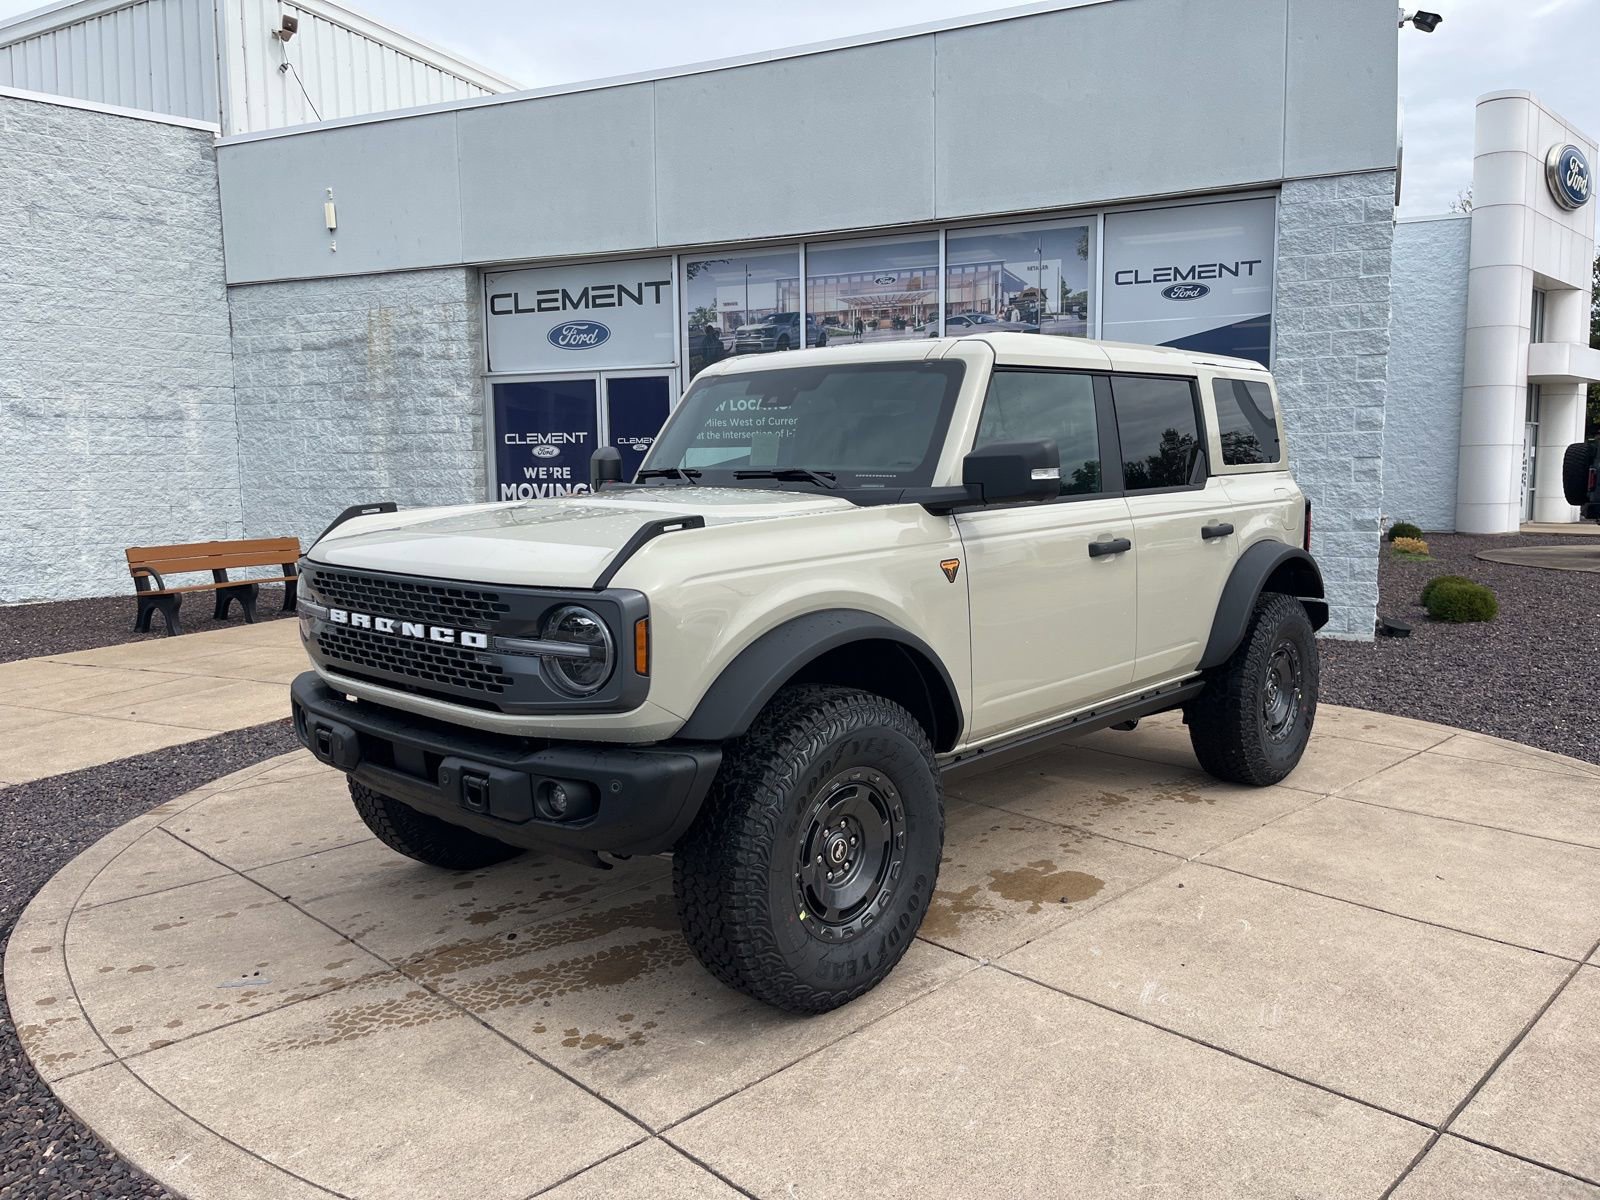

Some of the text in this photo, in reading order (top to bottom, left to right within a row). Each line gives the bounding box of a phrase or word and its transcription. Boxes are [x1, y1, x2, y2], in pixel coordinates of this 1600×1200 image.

[1566, 156, 1589, 195] Ford
[1115, 260, 1262, 285] CLEMENT
[490, 280, 670, 315] CLEMENT
[1170, 285, 1200, 298] Ford
[558, 325, 599, 345] Ford
[729, 418, 753, 427] West
[755, 417, 765, 426] of
[504, 432, 588, 445] CLEMENT
[707, 430, 720, 440] the
[537, 446, 556, 456] Ford
[523, 466, 571, 480] WE'RE
[330, 608, 488, 649] BRONCO
